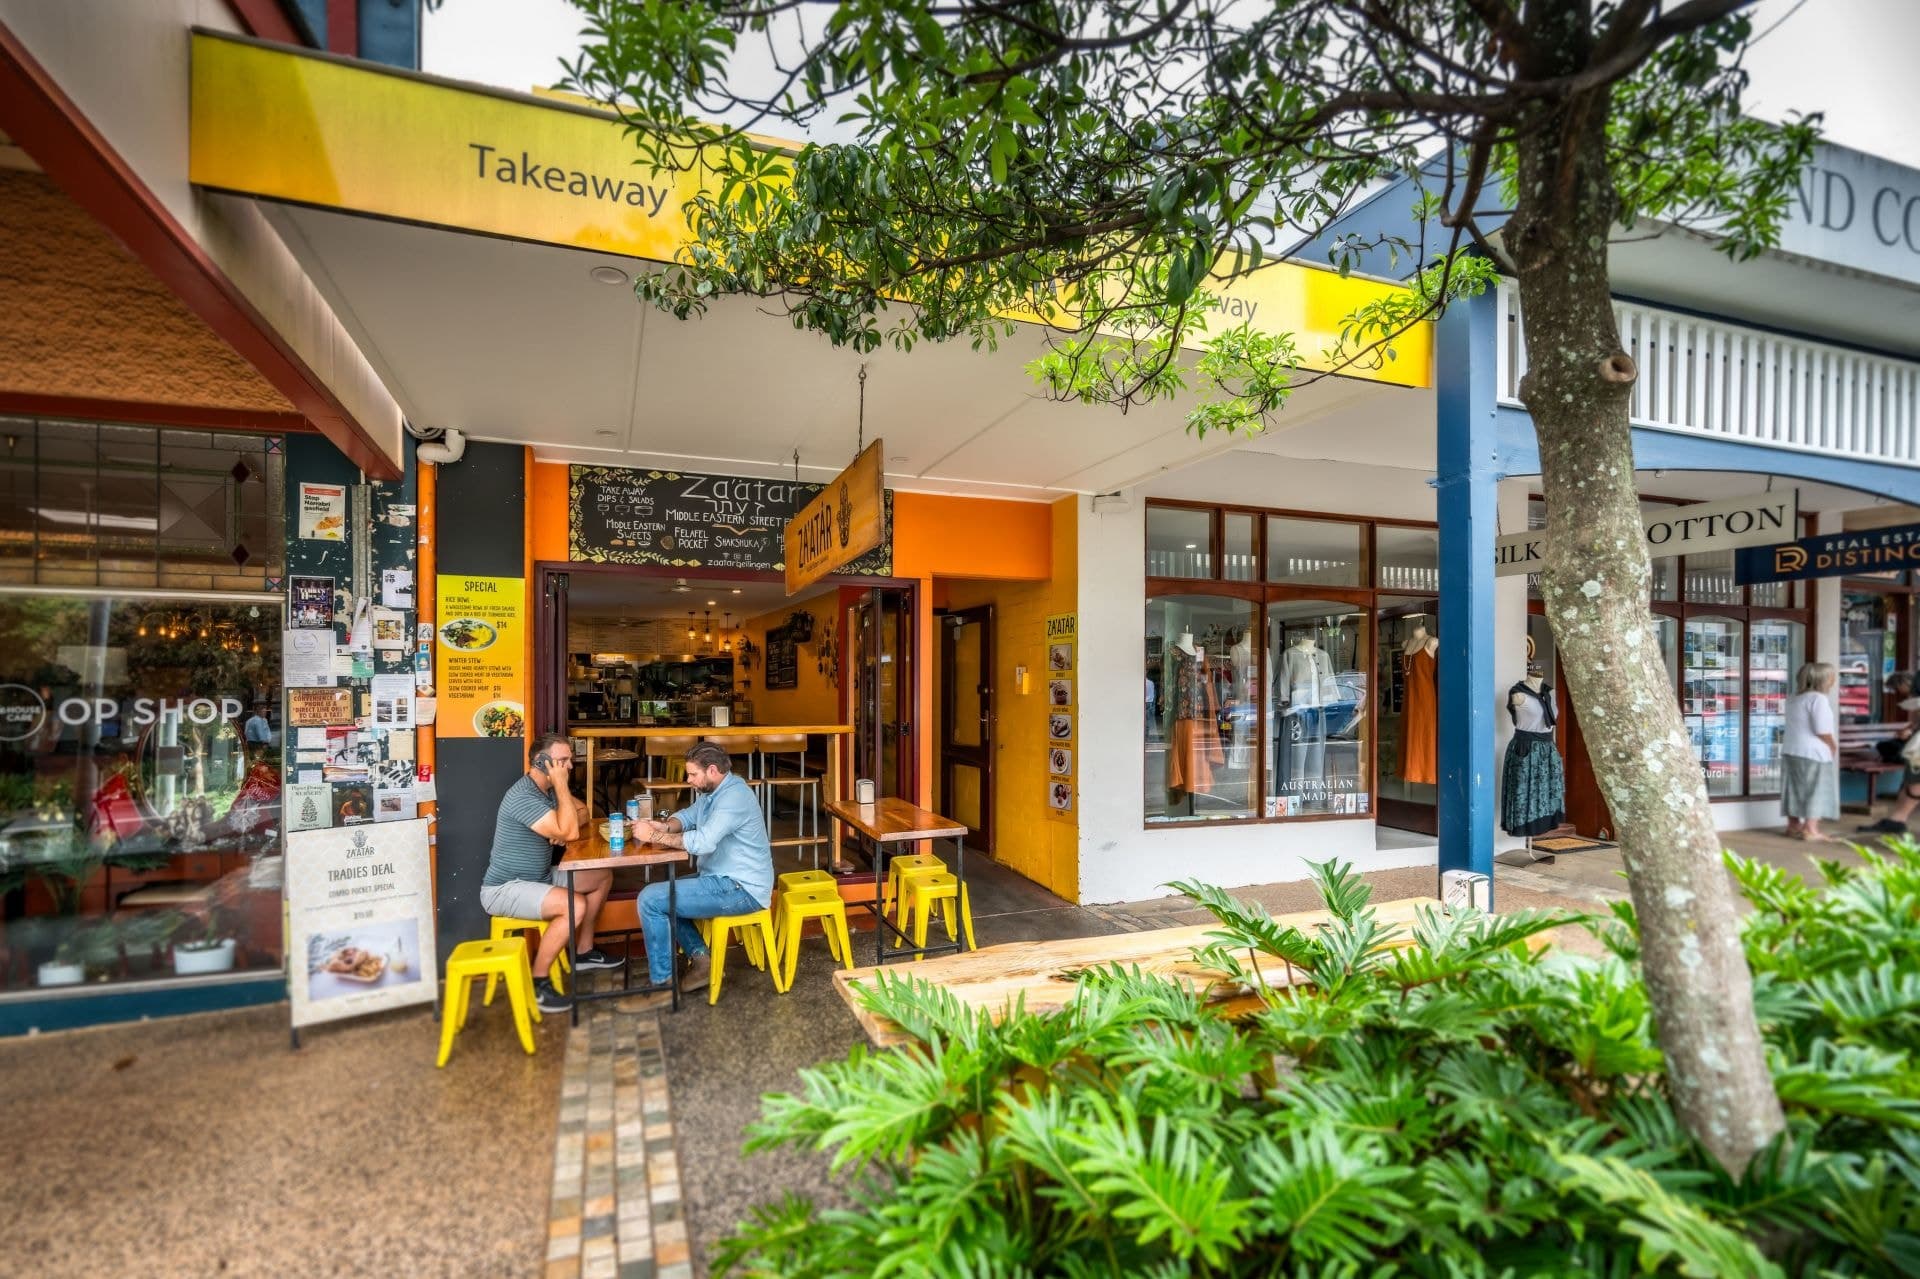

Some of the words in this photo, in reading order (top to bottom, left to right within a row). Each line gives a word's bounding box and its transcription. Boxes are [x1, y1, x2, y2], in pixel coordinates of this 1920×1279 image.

[469, 143, 668, 218] Takeaway
[600, 486, 620, 494] TAKE
[622, 486, 646, 495] AWAY
[597, 494, 616, 503] DIPS
[628, 496, 654, 505] SALADS
[665, 508, 700, 521] MIDDLE
[702, 512, 745, 525] EASTERN
[750, 516, 782, 527] STREET
[606, 519, 631, 530] MIDDLE
[633, 521, 666, 532] EASTERN
[1647, 505, 1786, 545] OTTON
[617, 530, 652, 541] SWEETS
[674, 526, 709, 539] FELAFEL
[678, 538, 709, 549] POCKET
[1825, 537, 1870, 551] REAL
[1881, 531, 1920, 545] EST
[464, 581, 498, 593] SPECIAL
[58, 698, 119, 725] OP
[133, 698, 243, 725] SHOP
[1281, 779, 1353, 791] AUSTRALIAN
[1302, 791, 1334, 801] MADE
[328, 866, 368, 882] TRADIES
[371, 863, 396, 876] DEAL
